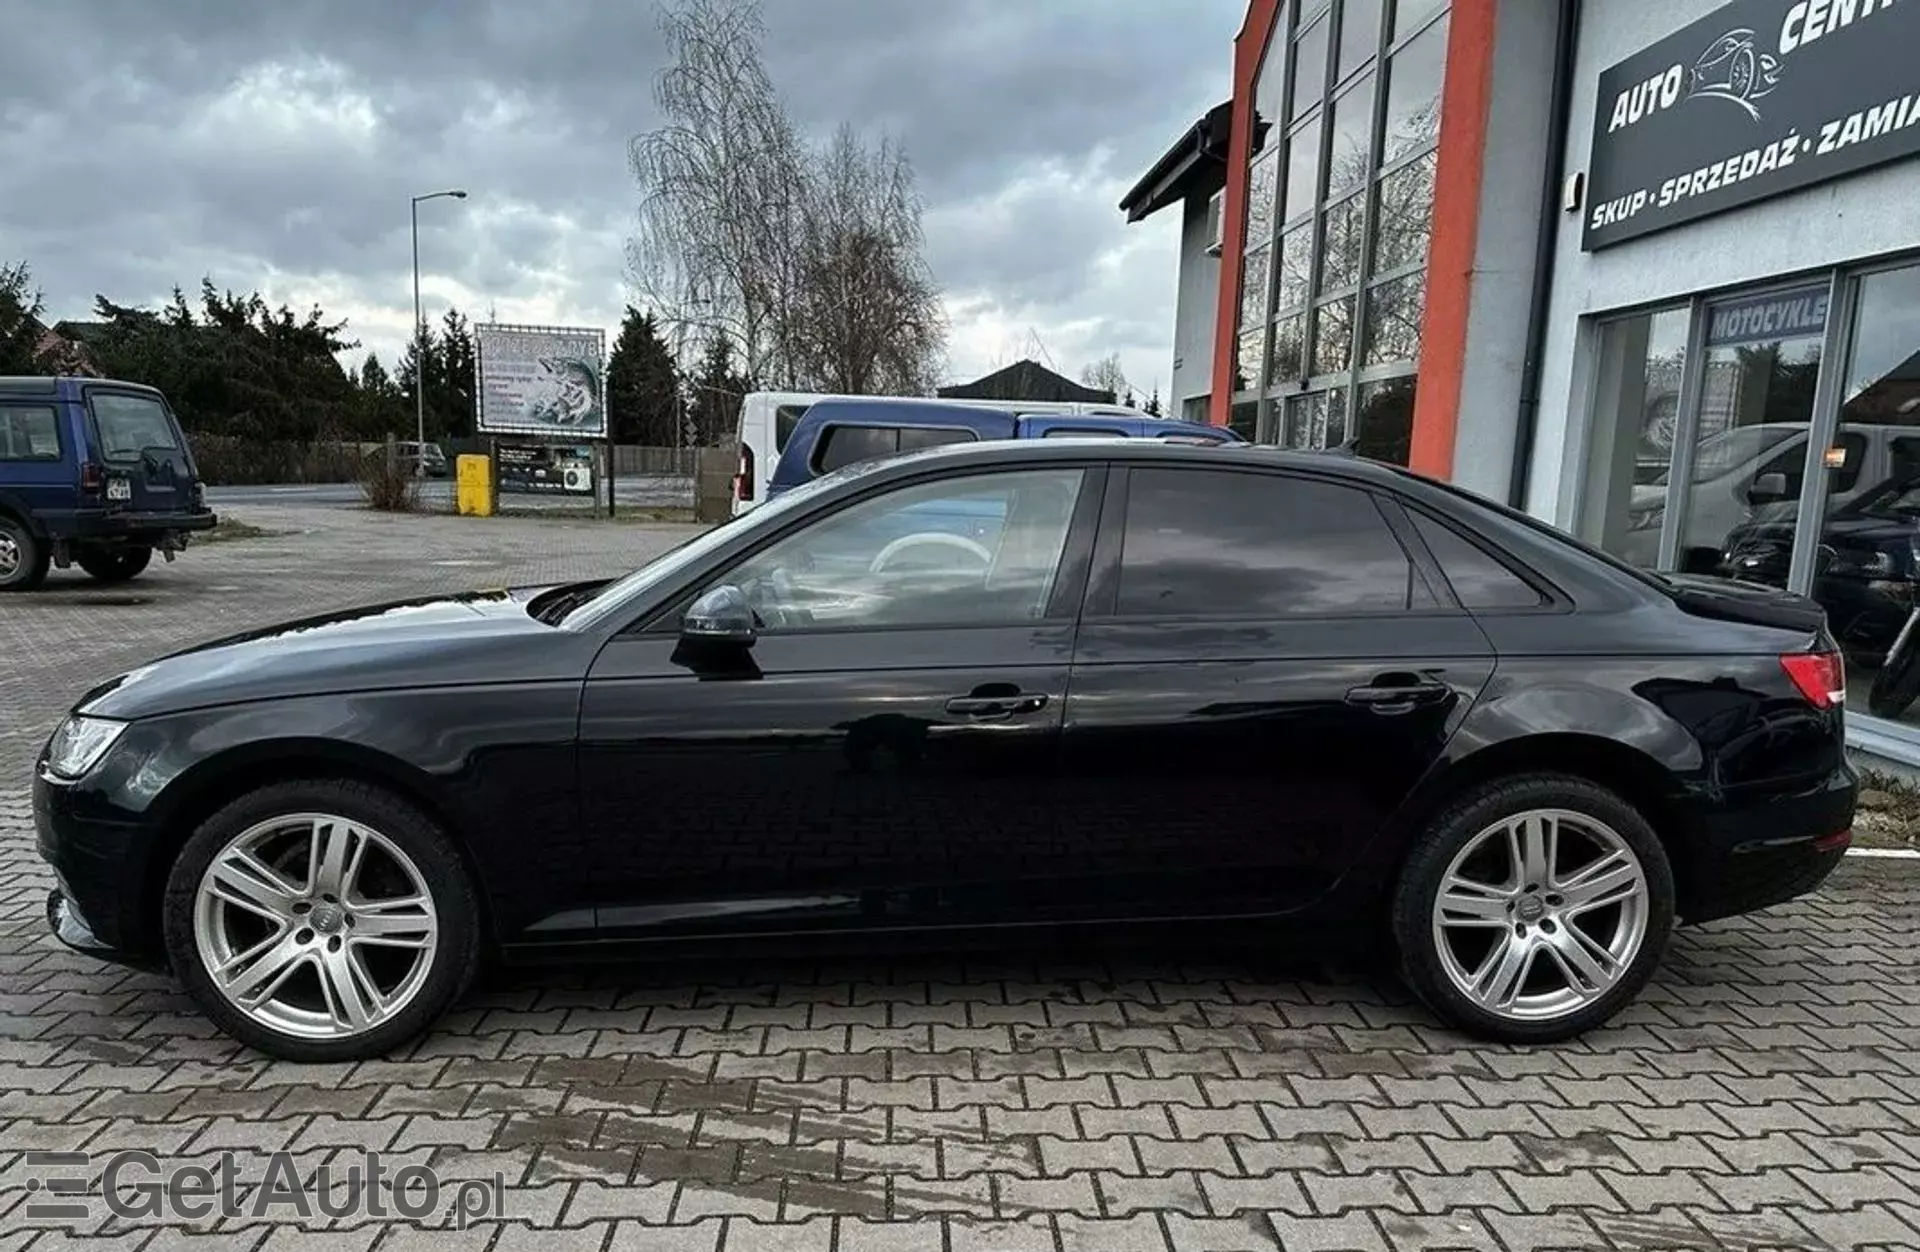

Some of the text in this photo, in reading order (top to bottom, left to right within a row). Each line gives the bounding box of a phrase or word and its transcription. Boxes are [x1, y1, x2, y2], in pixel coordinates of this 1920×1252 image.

[1608, 64, 1683, 133] AUTO
[1590, 190, 1646, 230] SKUP
[1658, 127, 1799, 207] SPRZEDAŻ
[1710, 294, 1828, 339] MOTOCYKLE
